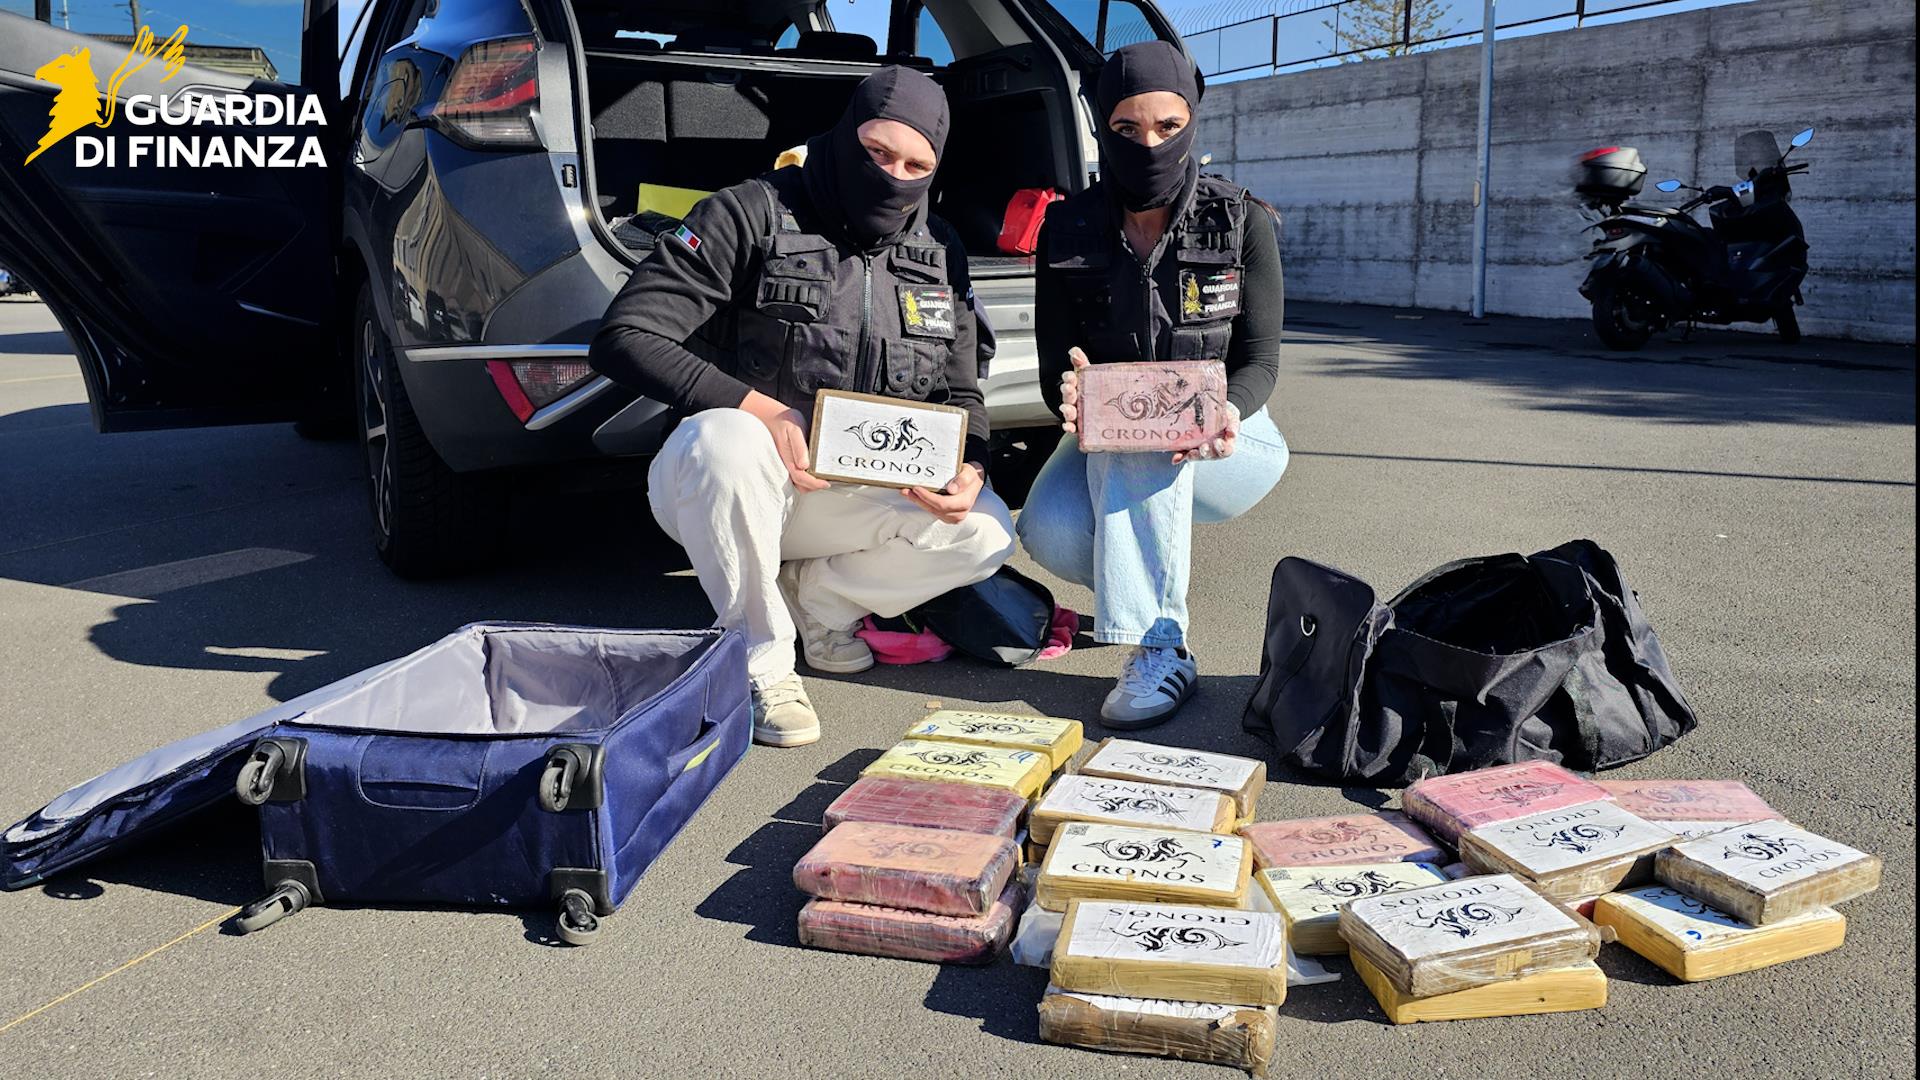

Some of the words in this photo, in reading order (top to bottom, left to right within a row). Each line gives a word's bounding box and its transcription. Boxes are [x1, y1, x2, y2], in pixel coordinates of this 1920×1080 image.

[1202, 283, 1238, 294] GUARDIA
[1102, 428, 1193, 441] CRONOS
[838, 454, 936, 477] CRONOS
[955, 712, 1051, 725] CRONOS
[889, 763, 994, 780] CRONOS
[1111, 761, 1218, 784] CRONOS
[1085, 781, 1194, 800] CRONOS
[1500, 807, 1600, 834] CRONOS
[1212, 838, 1223, 848] 7
[1292, 843, 1408, 861] CRONOS
[1072, 862, 1205, 883] CRONOS
[1758, 848, 1841, 880] CRONOS
[1380, 883, 1502, 909] CRONOS
[1109, 908, 1250, 926] CRONOS
